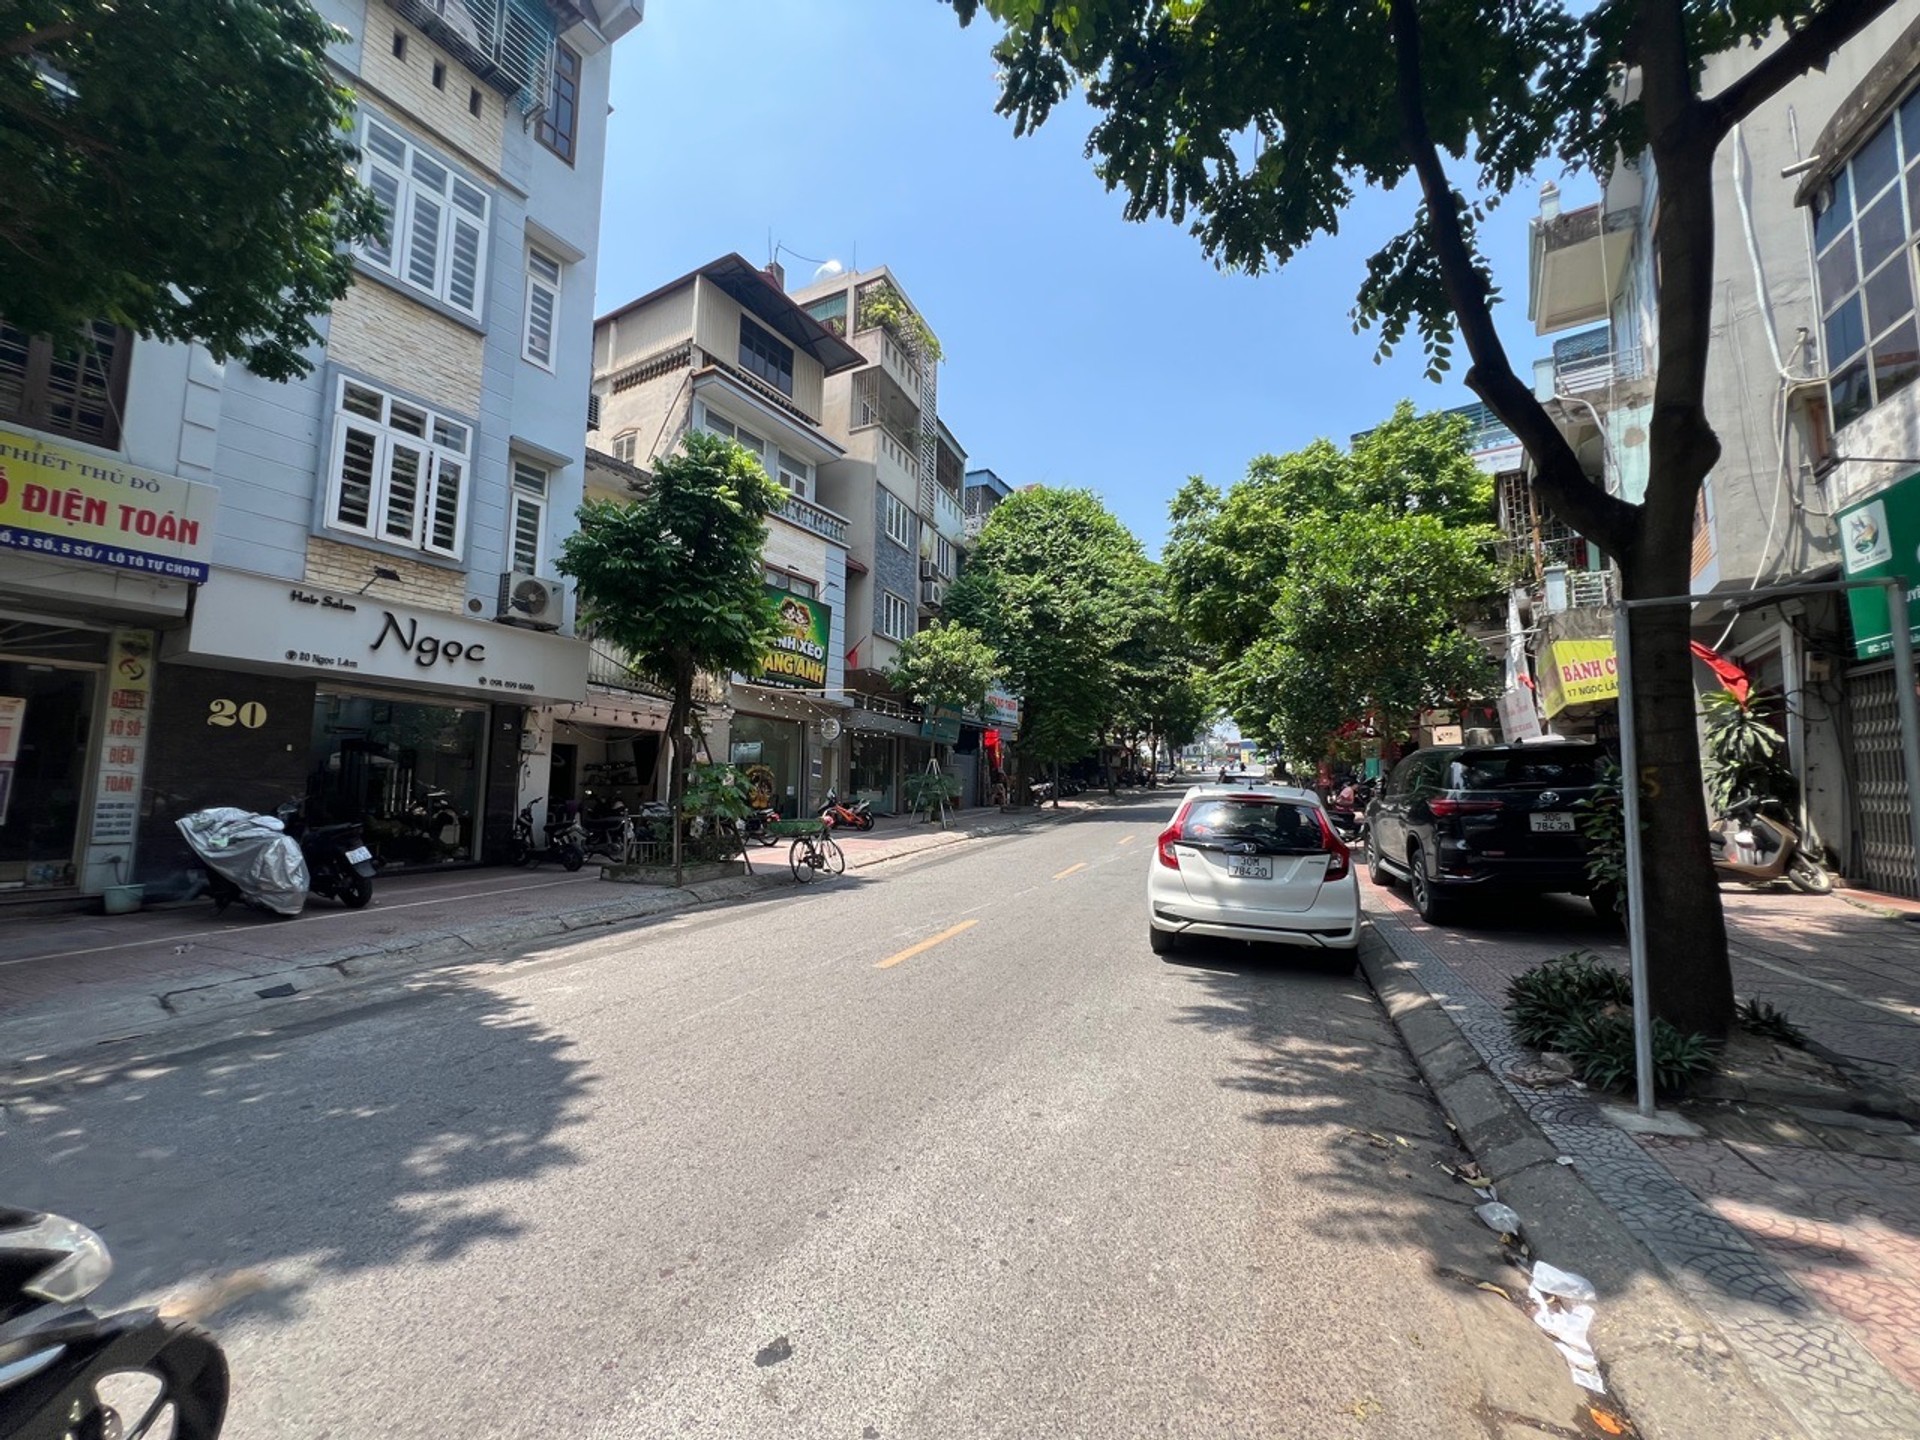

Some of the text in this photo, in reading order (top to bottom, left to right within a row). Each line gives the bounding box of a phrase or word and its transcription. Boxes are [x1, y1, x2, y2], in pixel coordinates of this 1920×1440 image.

[76, 463, 124, 484] THỦ
[130, 477, 160, 493] ĐÔ
[21, 483, 107, 526] ĐIỆN
[118, 504, 199, 545] TOÁN
[19, 535, 29, 546] 3
[61, 543, 72, 554] 5
[165, 563, 200, 577] CHỌN
[290, 590, 319, 606] Hair
[369, 611, 486, 667] Ngọc
[1562, 659, 1603, 682] BÁNH
[1567, 689, 1577, 697] 17
[207, 699, 267, 728] 20
